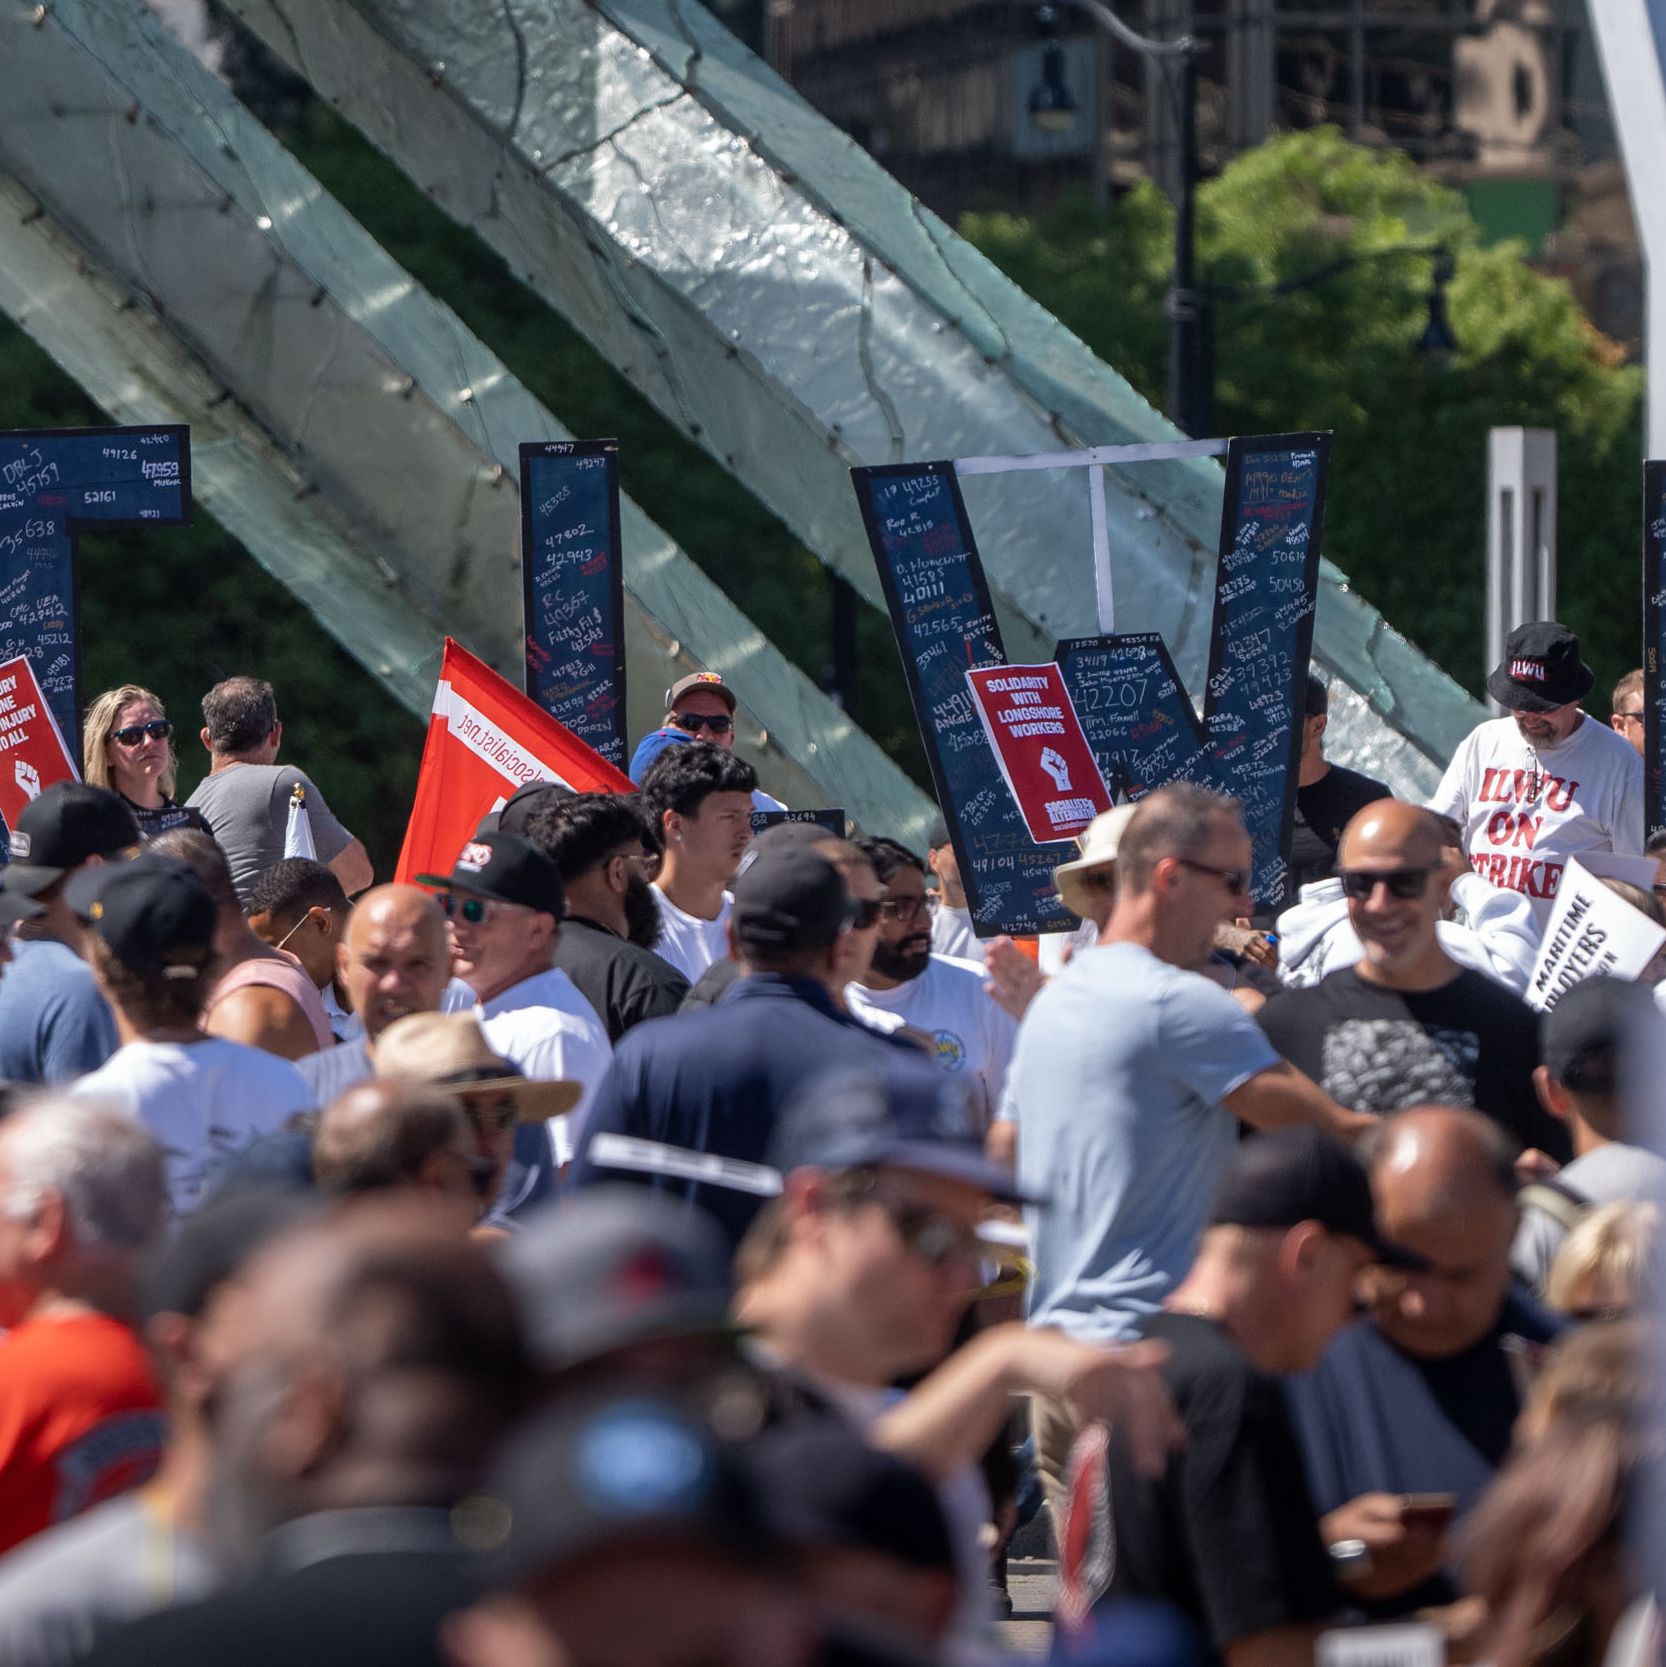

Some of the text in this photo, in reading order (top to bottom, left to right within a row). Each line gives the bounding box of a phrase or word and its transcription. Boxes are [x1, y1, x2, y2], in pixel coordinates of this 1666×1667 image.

[1509, 659, 1546, 682] ILWU
[986, 676, 1049, 693] SOLIDARITY
[1073, 678, 1147, 712] 42207
[1010, 692, 1042, 706] WITH
[0, 704, 37, 733] INJURY
[997, 707, 1065, 724] LONGSHORE
[7, 729, 29, 748] ALL
[1009, 721, 1065, 738] WORKERS
[1478, 767, 1580, 812] ILWU
[1487, 811, 1544, 850] ON
[973, 856, 1015, 874] 49104
[1469, 853, 1564, 900] TRIKE
[1535, 893, 1592, 992] MARITIME
